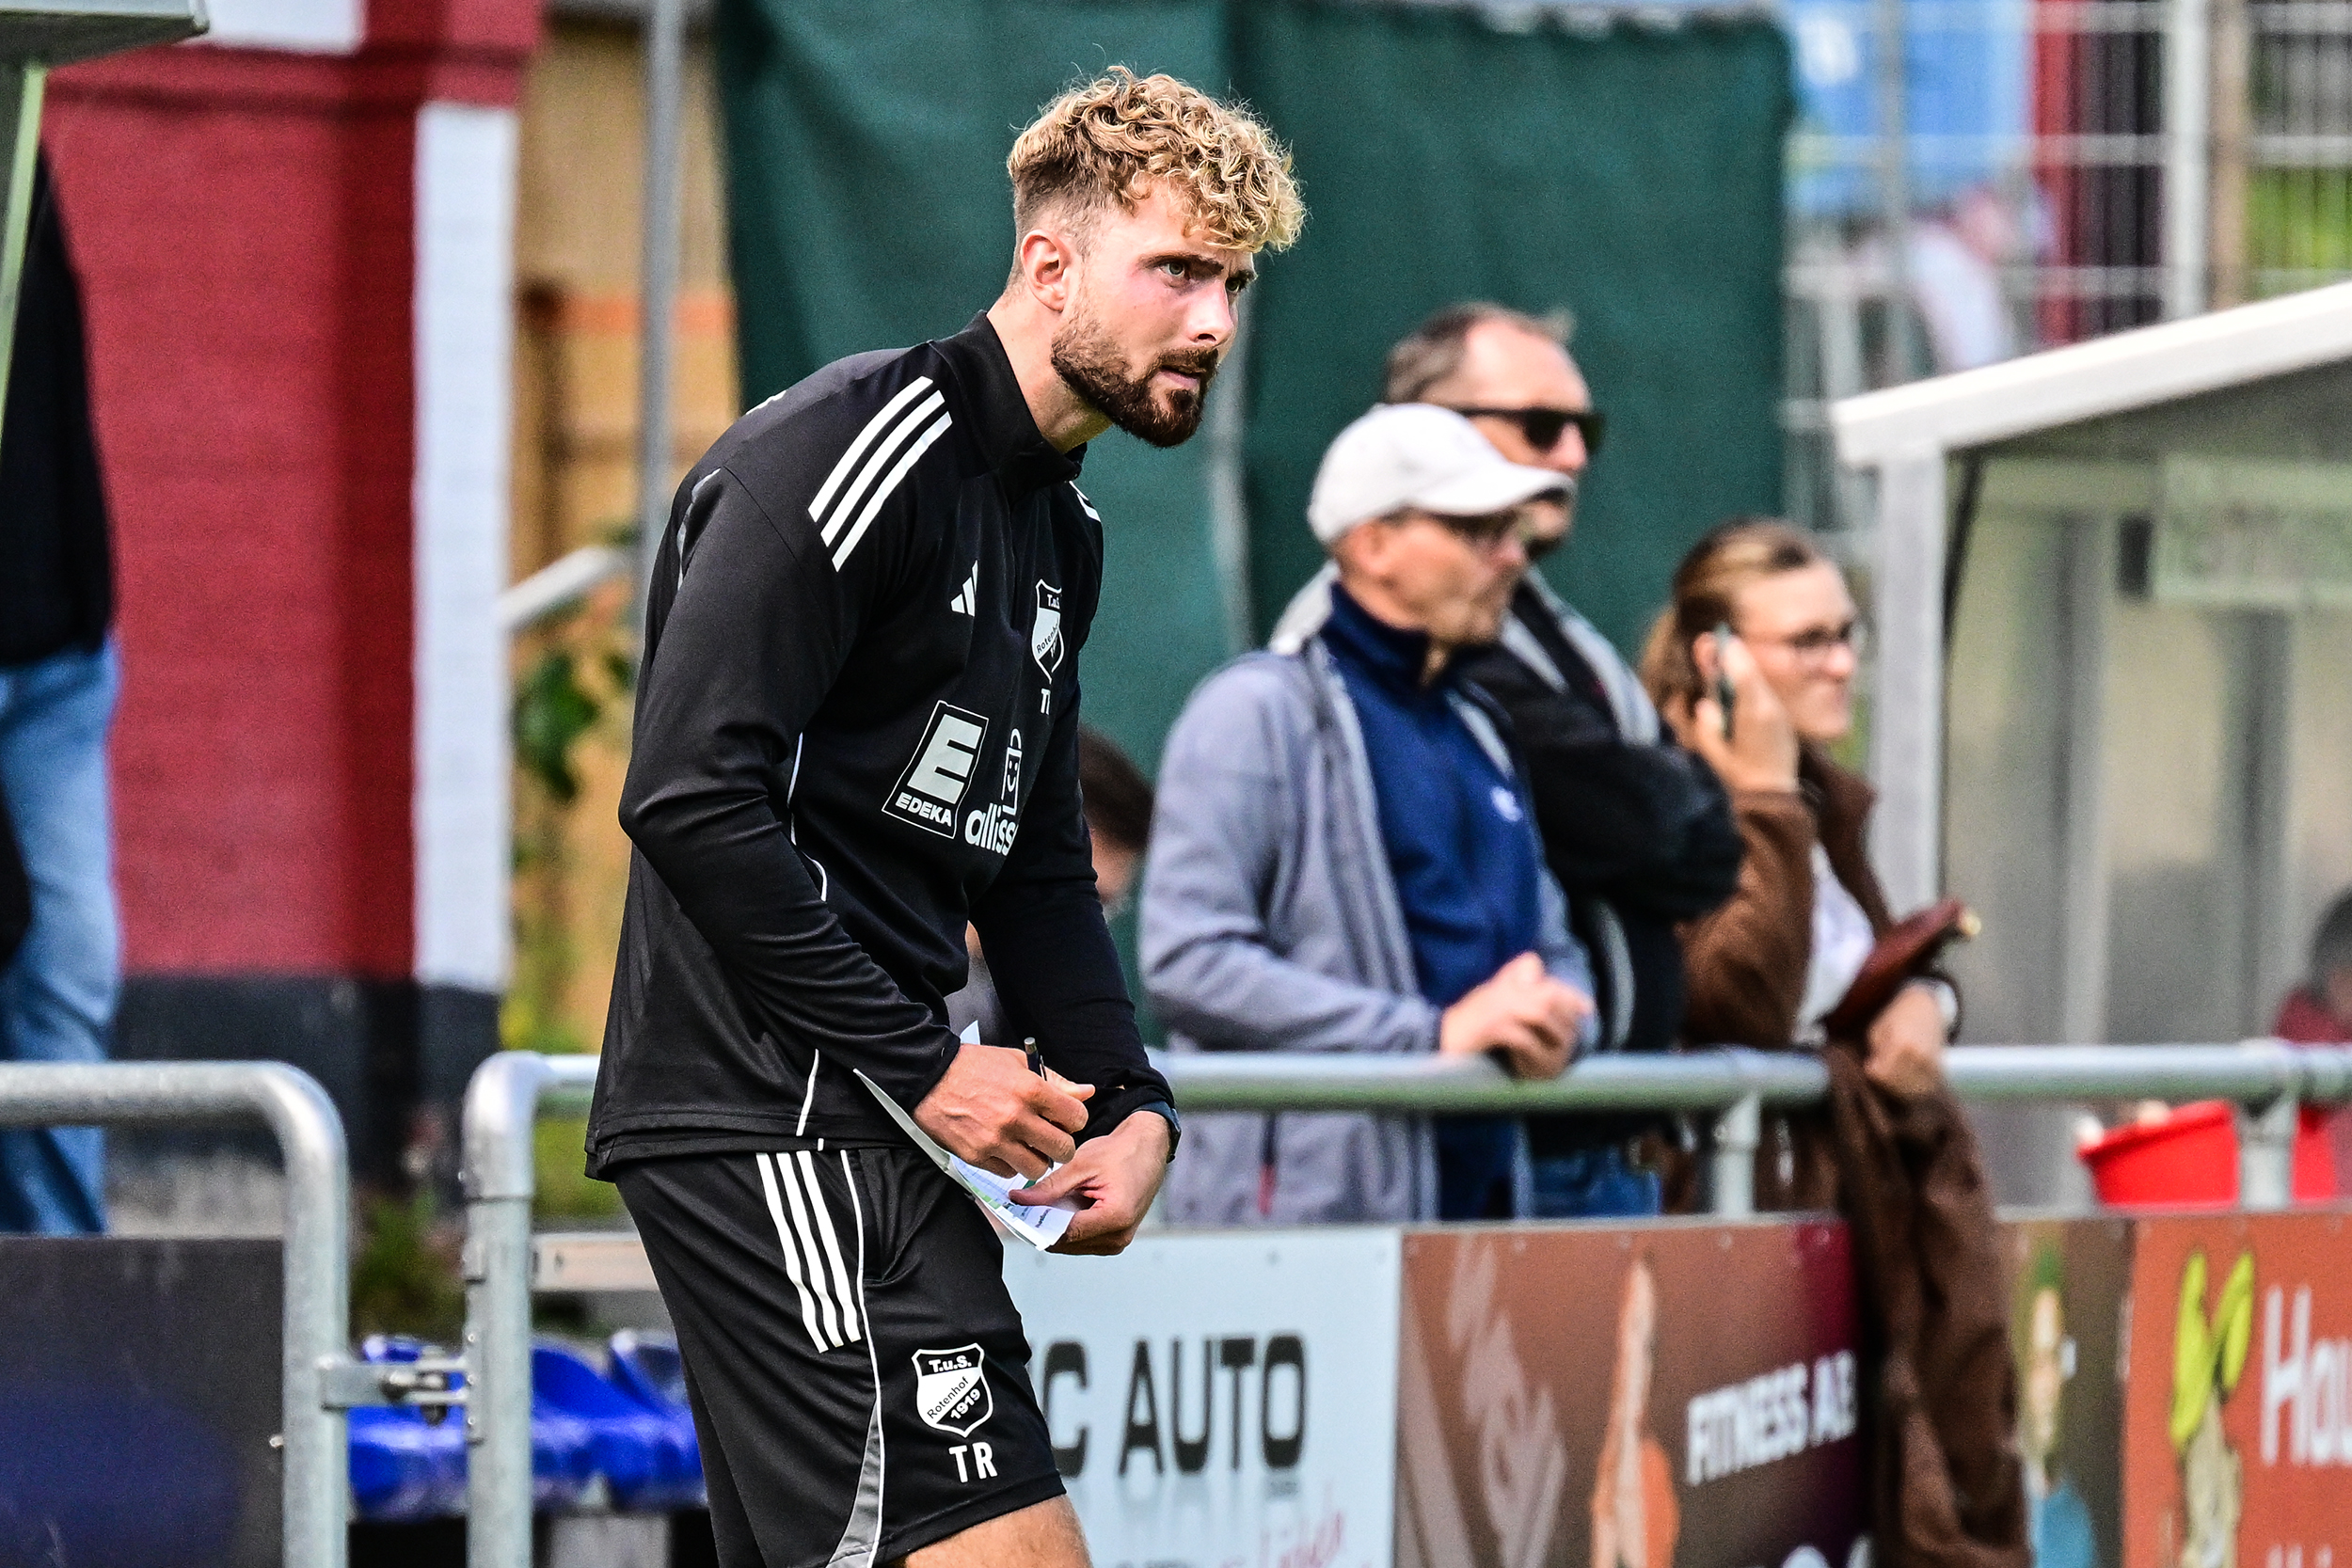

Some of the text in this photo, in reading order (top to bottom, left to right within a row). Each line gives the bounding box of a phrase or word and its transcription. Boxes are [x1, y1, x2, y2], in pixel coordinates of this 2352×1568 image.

[907, 714, 982, 804] E
[895, 791, 952, 827] EDEKA
[964, 802, 1019, 856] alliss
[928, 1354, 973, 1373] T.u.S.
[927, 1376, 969, 1418] Rotenhof
[950, 1388, 981, 1419] 1919
[1118, 1333, 1307, 1478] AUTO
[1687, 1362, 1809, 1486] FITNESS
[948, 1441, 998, 1483] TR
